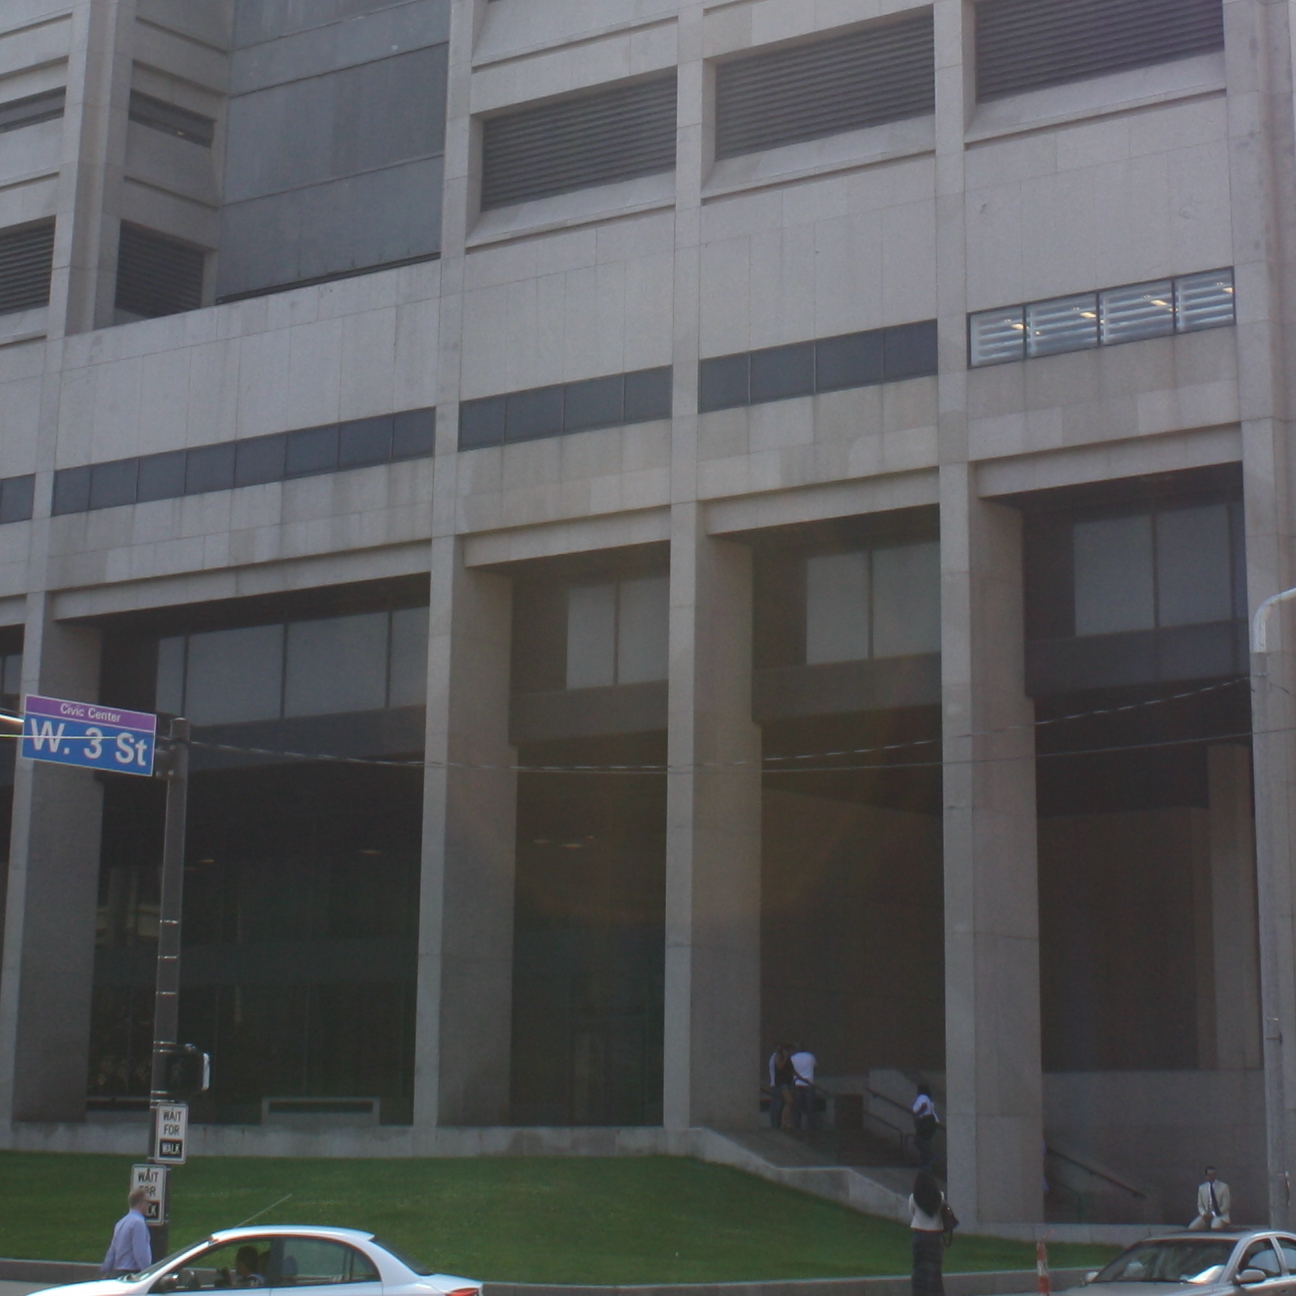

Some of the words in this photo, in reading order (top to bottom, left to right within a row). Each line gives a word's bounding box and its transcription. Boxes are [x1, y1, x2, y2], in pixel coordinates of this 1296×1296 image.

[60, 703, 84, 717] Civic
[88, 707, 122, 722] Center
[30, 718, 70, 755] W.
[84, 727, 103, 760] 3
[115, 731, 148, 766] St
[163, 1111, 182, 1122] WAIT
[164, 1124, 180, 1135] FOR
[161, 1142, 181, 1155] WALK
[138, 1171, 159, 1183] WAIT
